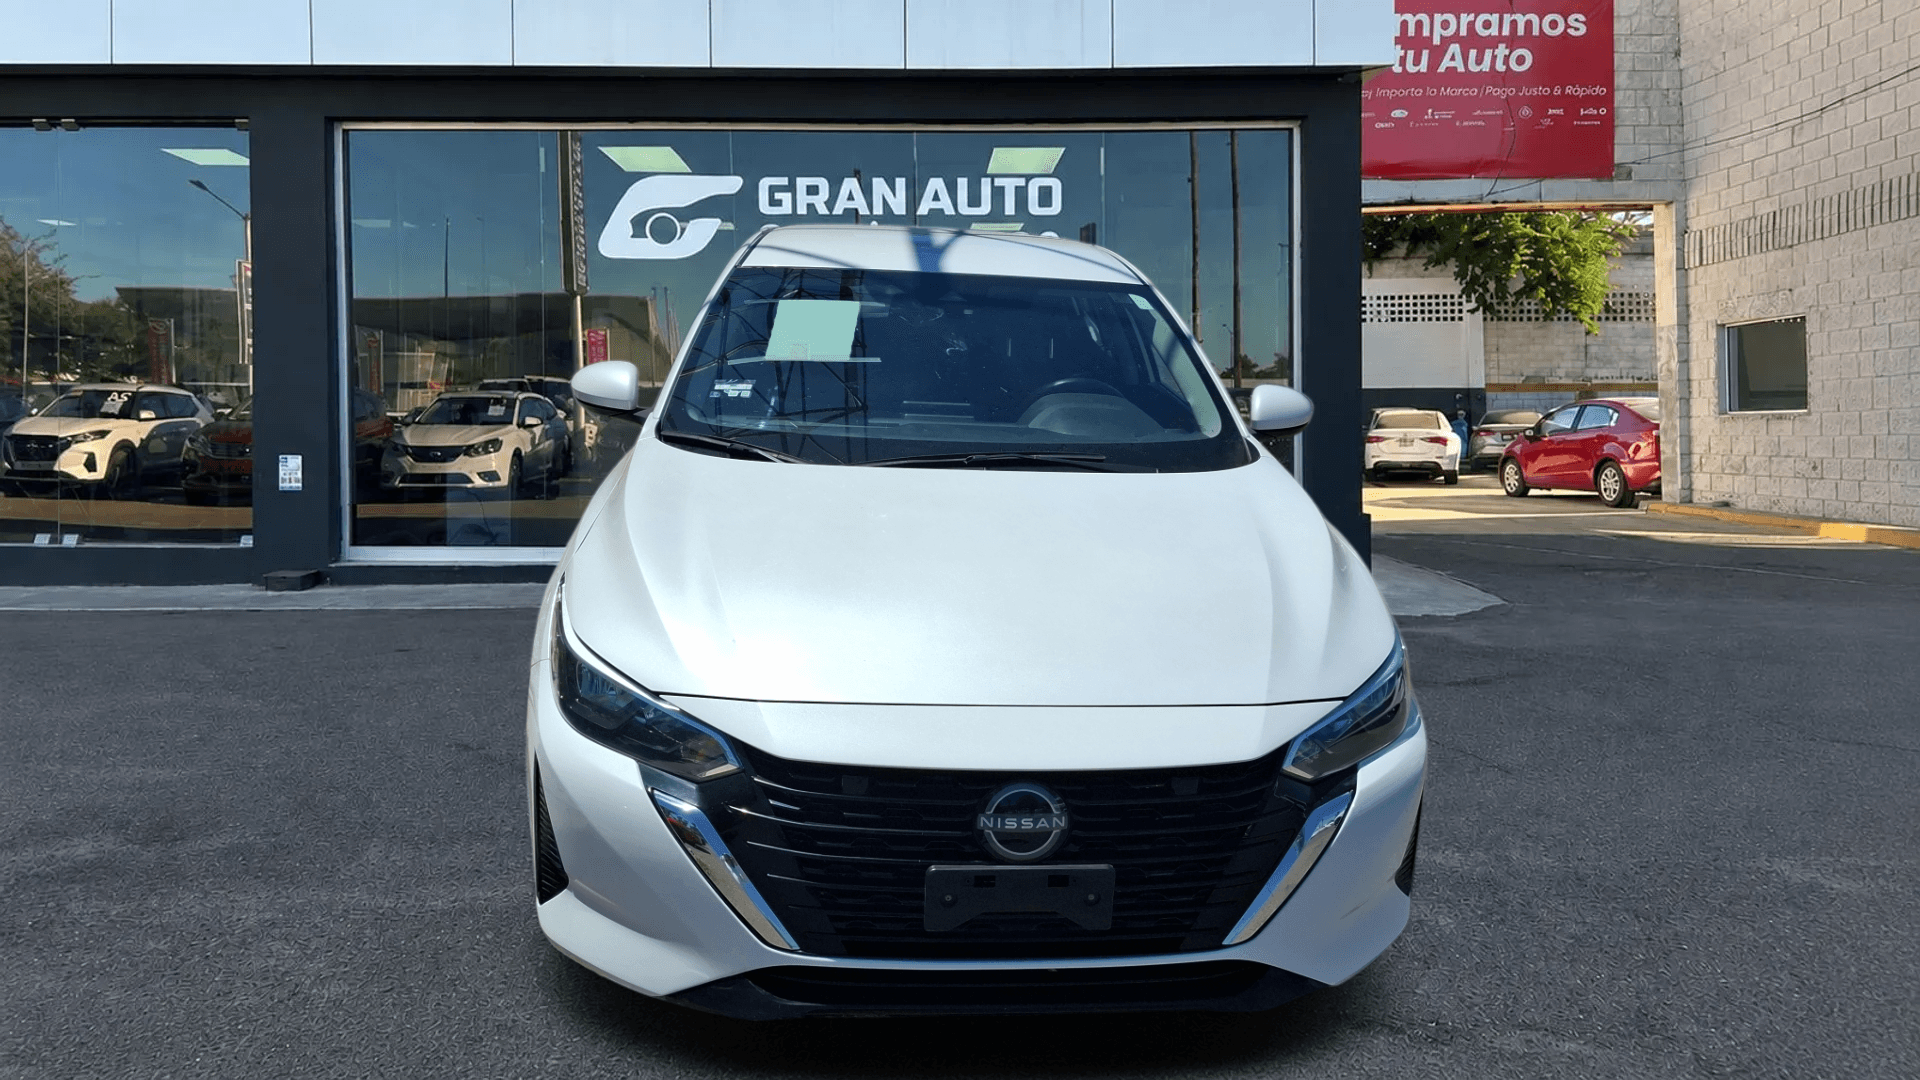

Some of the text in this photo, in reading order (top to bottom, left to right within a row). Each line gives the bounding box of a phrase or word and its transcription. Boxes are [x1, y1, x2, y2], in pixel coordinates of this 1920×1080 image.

[1393, 43, 1533, 73] tu Auto
[1376, 87, 1423, 100] Importa
[1426, 86, 1437, 97] la
[1440, 86, 1478, 97] Marca
[1519, 85, 1551, 96] Justo
[1553, 85, 1562, 96] &
[758, 176, 1063, 216] GRAN AUTO
[980, 816, 1066, 829] NISSAN
